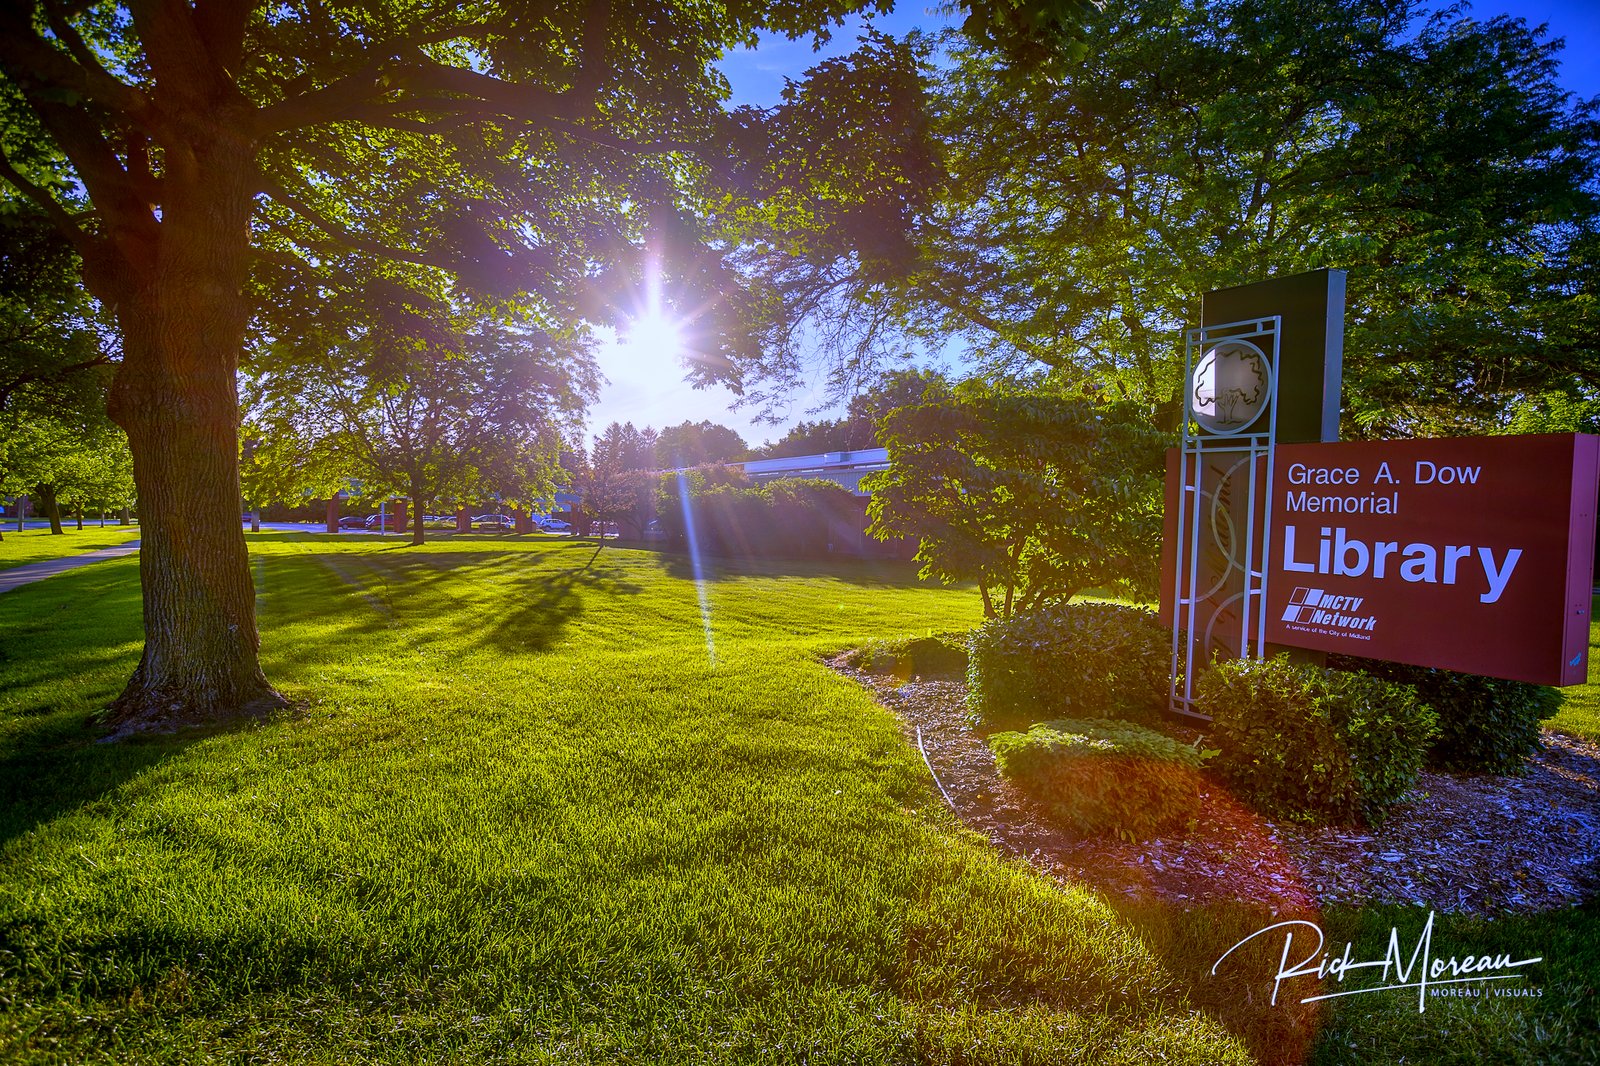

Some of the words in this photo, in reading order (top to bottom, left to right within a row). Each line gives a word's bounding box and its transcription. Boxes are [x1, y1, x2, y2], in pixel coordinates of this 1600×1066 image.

[1287, 463, 1360, 485] Grace
[1373, 461, 1400, 484] A.
[1415, 461, 1482, 485] Dow
[1286, 491, 1399, 514] Memorial
[1283, 525, 1523, 604] Library
[1318, 594, 1364, 612] MCTV
[1312, 609, 1377, 631] Network
[1291, 625, 1311, 633] service
[1328, 629, 1340, 638] City
[1348, 632, 1371, 640] Midland
